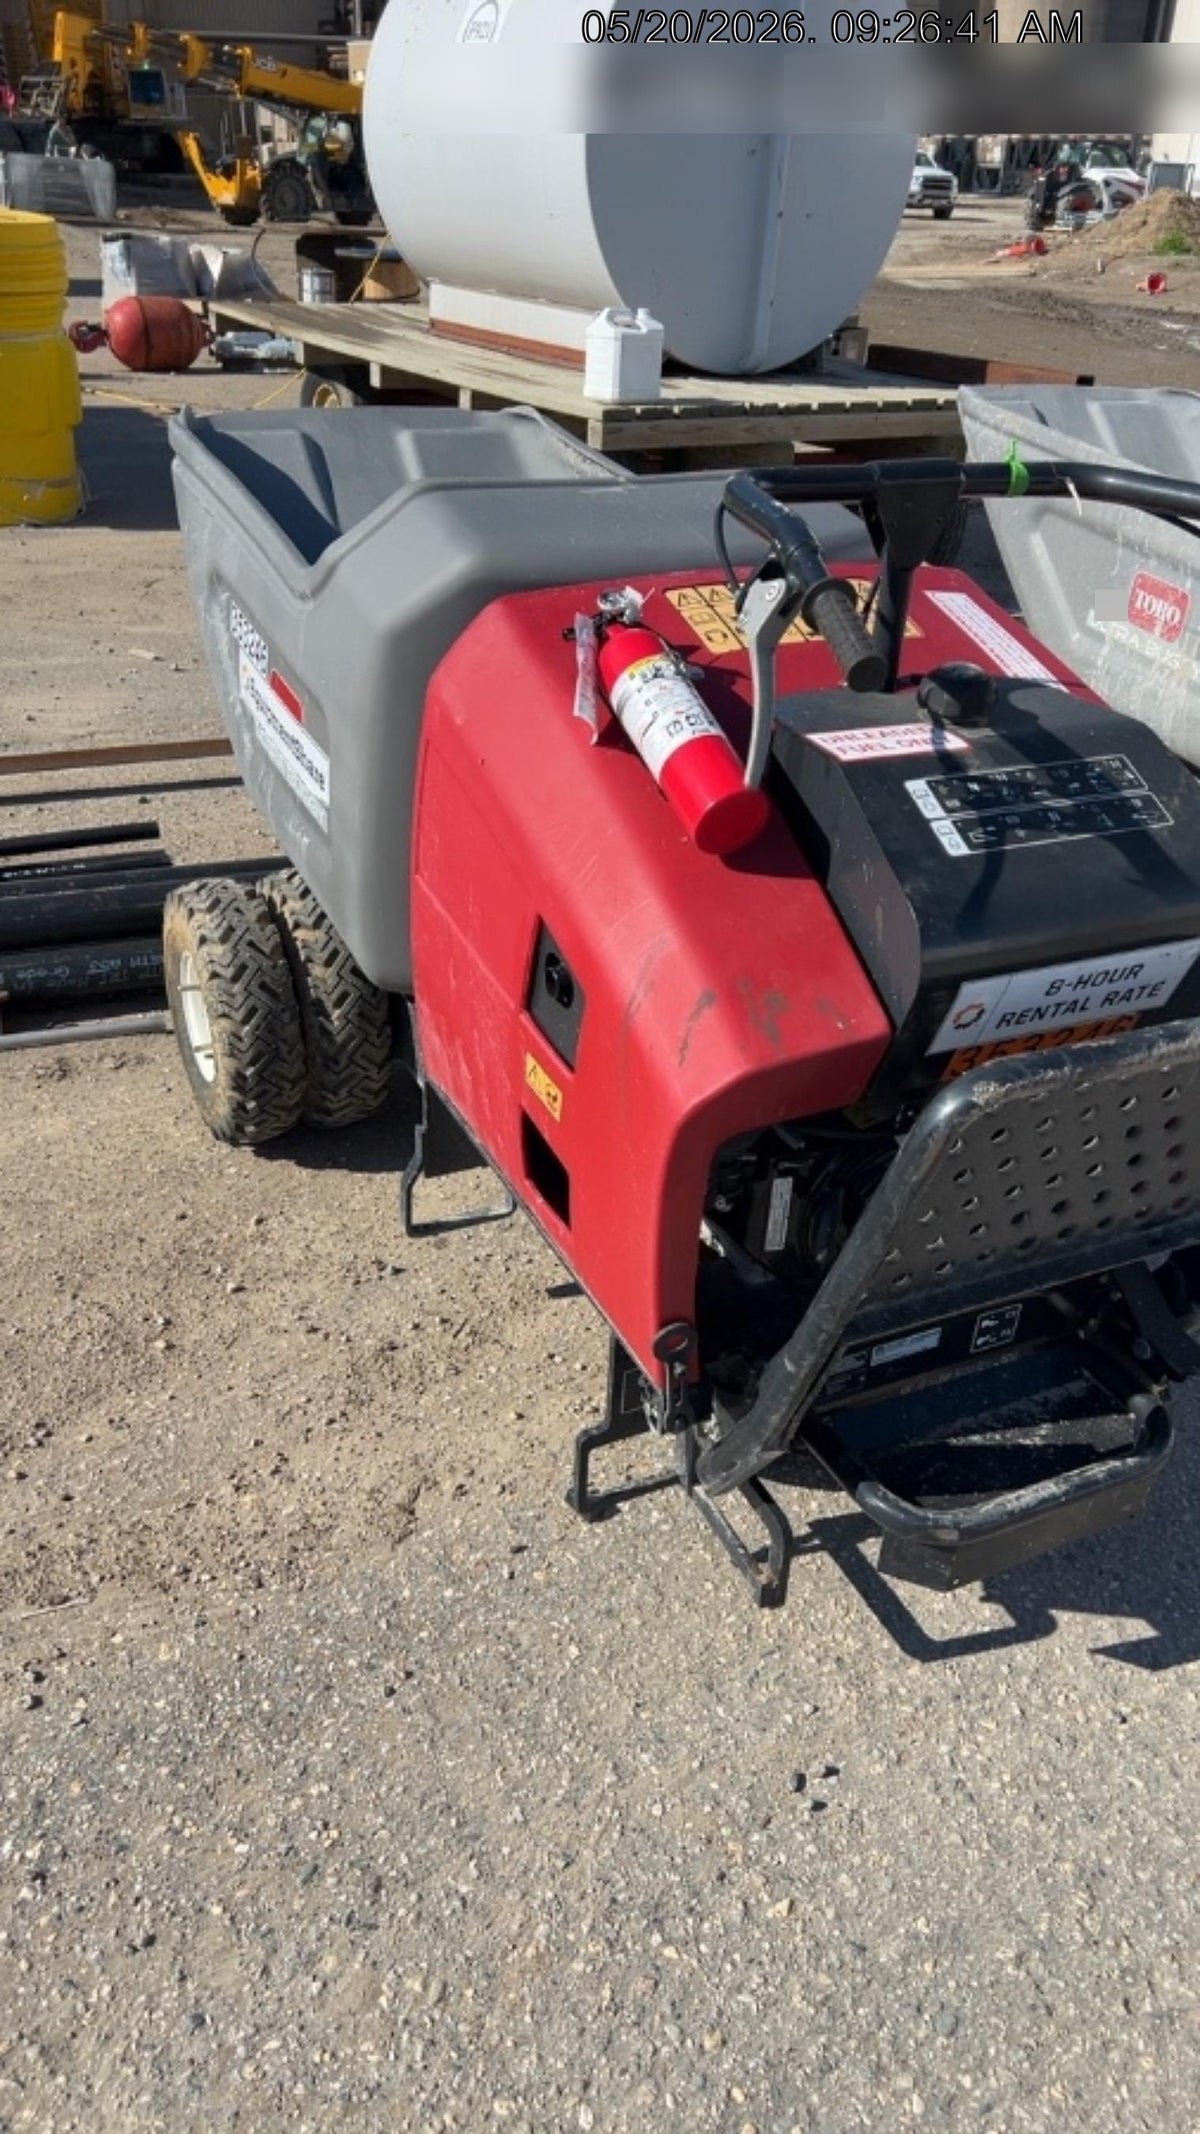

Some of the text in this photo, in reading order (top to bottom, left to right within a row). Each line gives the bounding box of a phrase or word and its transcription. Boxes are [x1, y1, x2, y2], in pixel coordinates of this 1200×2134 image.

[1135, 588, 1181, 624] TORO
[1044, 963, 1145, 998] 8-HOUR
[995, 980, 1167, 1030] RENTAL RATE
